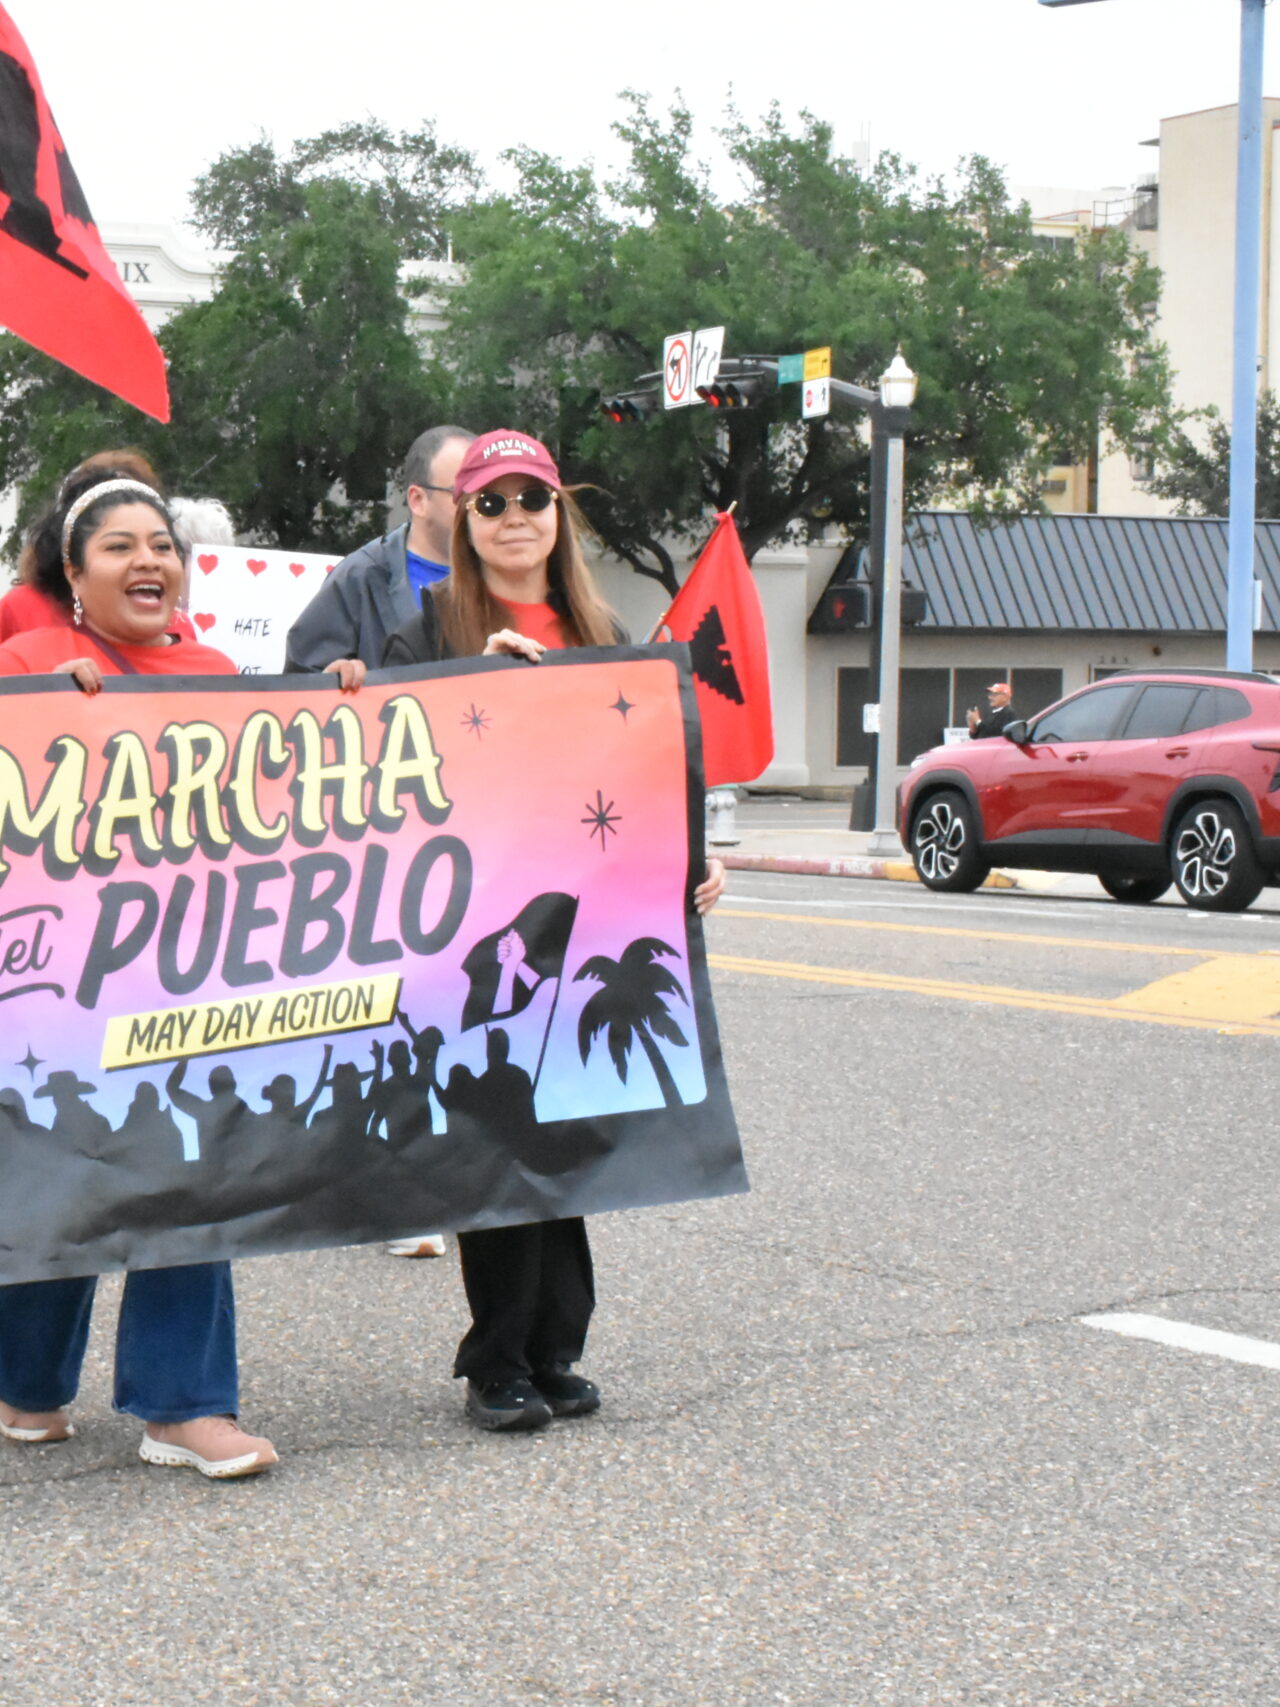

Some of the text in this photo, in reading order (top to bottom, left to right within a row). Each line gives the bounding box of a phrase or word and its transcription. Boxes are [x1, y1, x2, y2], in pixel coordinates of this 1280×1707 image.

[113, 262, 152, 283] IX
[483, 439, 537, 460] HARVARD
[234, 618, 271, 637] HATE
[238, 665, 262, 675] OT
[74, 835, 474, 1010] PUEBLO
[126, 983, 376, 1056] MAY DAY ACTION
